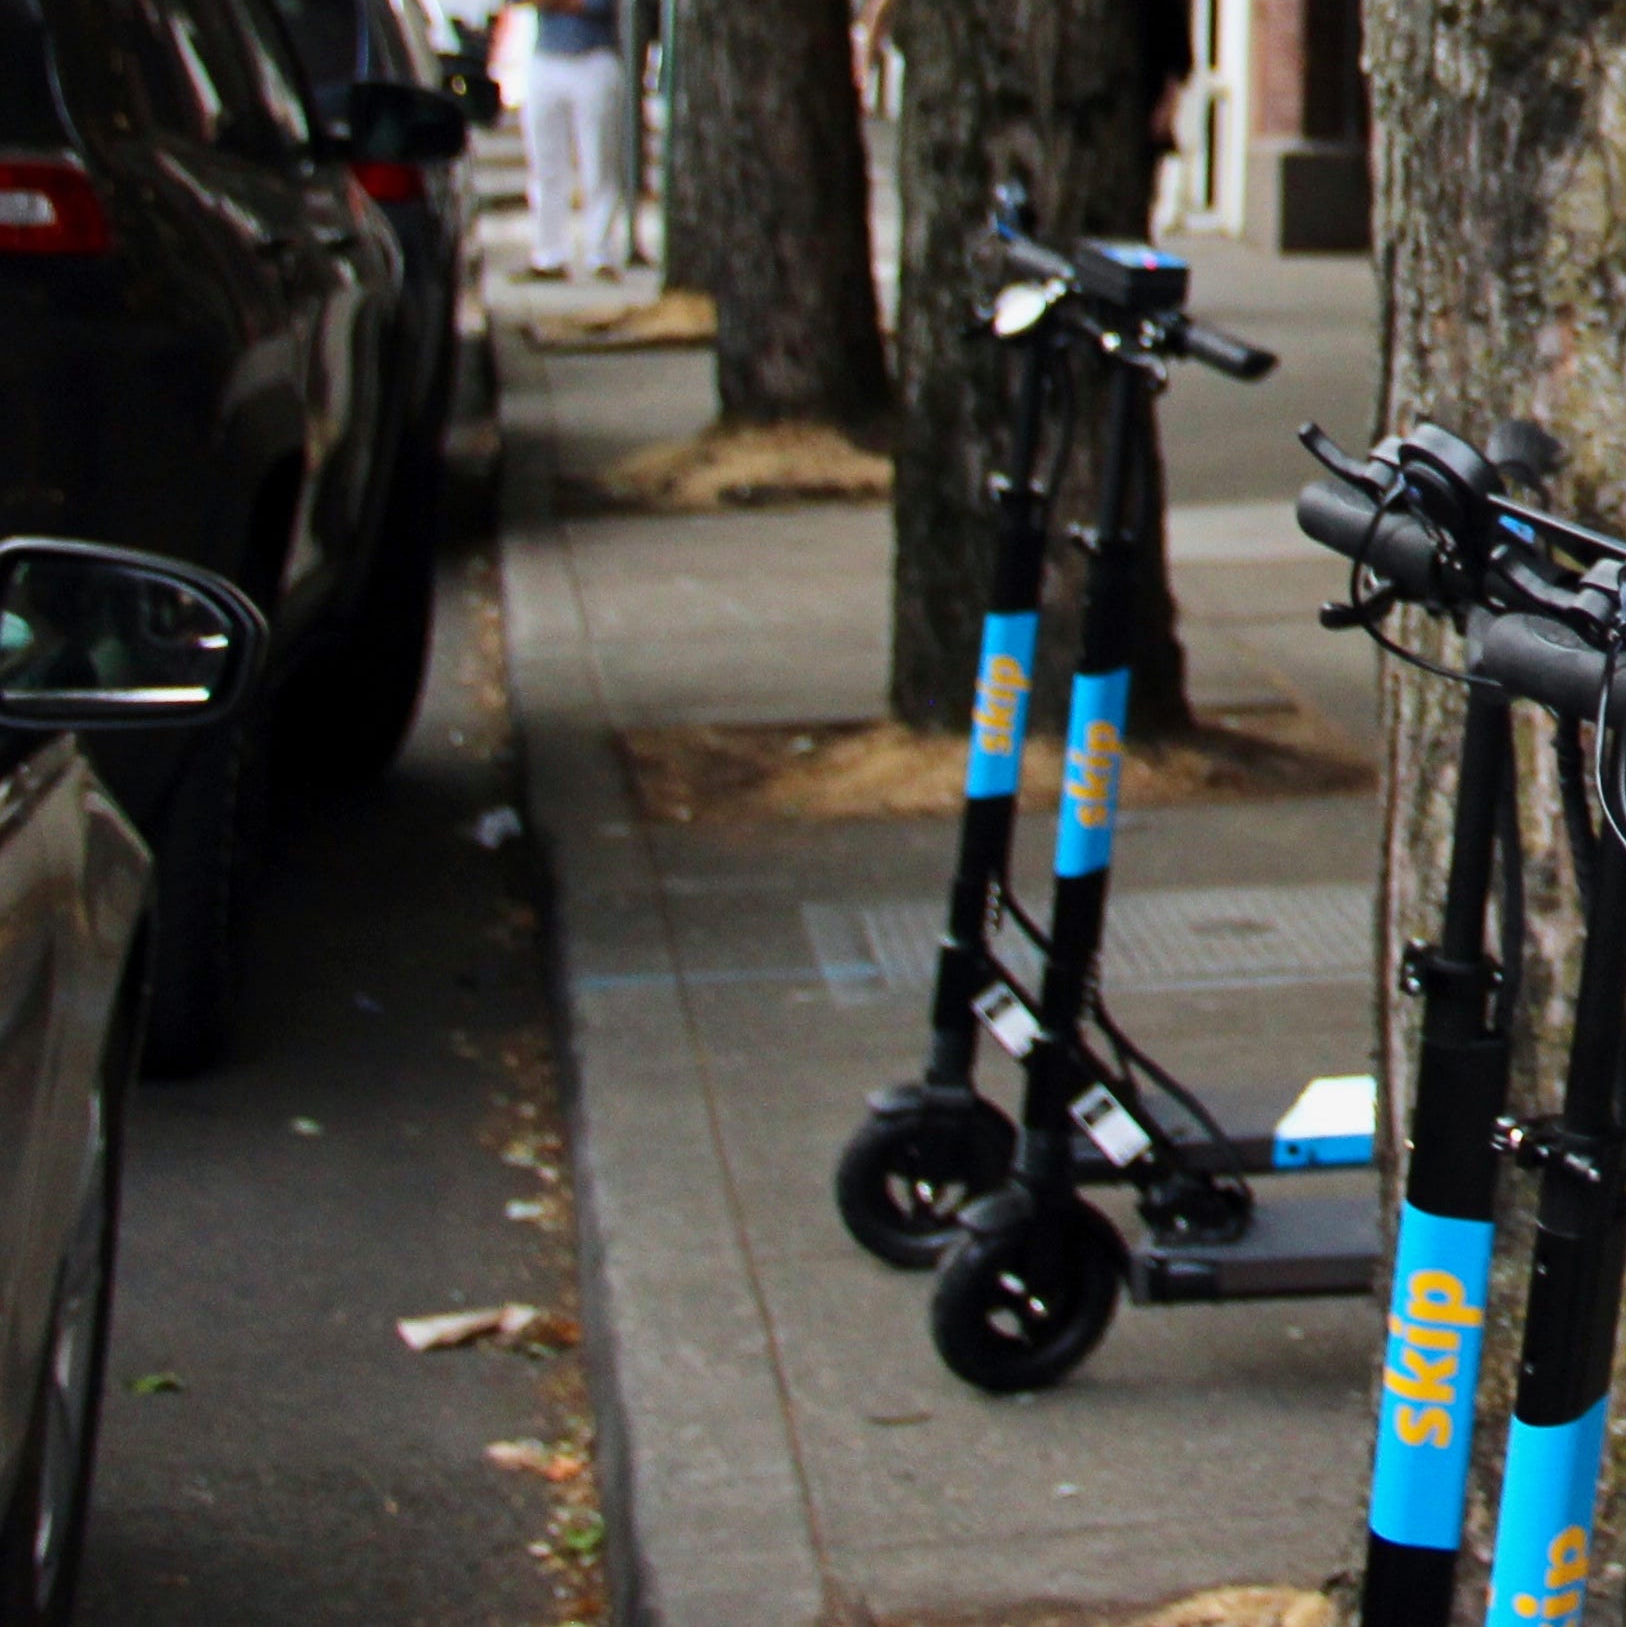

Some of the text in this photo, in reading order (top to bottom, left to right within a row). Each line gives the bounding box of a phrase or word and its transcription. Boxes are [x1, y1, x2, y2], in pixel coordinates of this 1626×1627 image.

[971, 656, 1031, 752] skip
[1067, 721, 1122, 828] skip
[1384, 1271, 1483, 1447] skip
